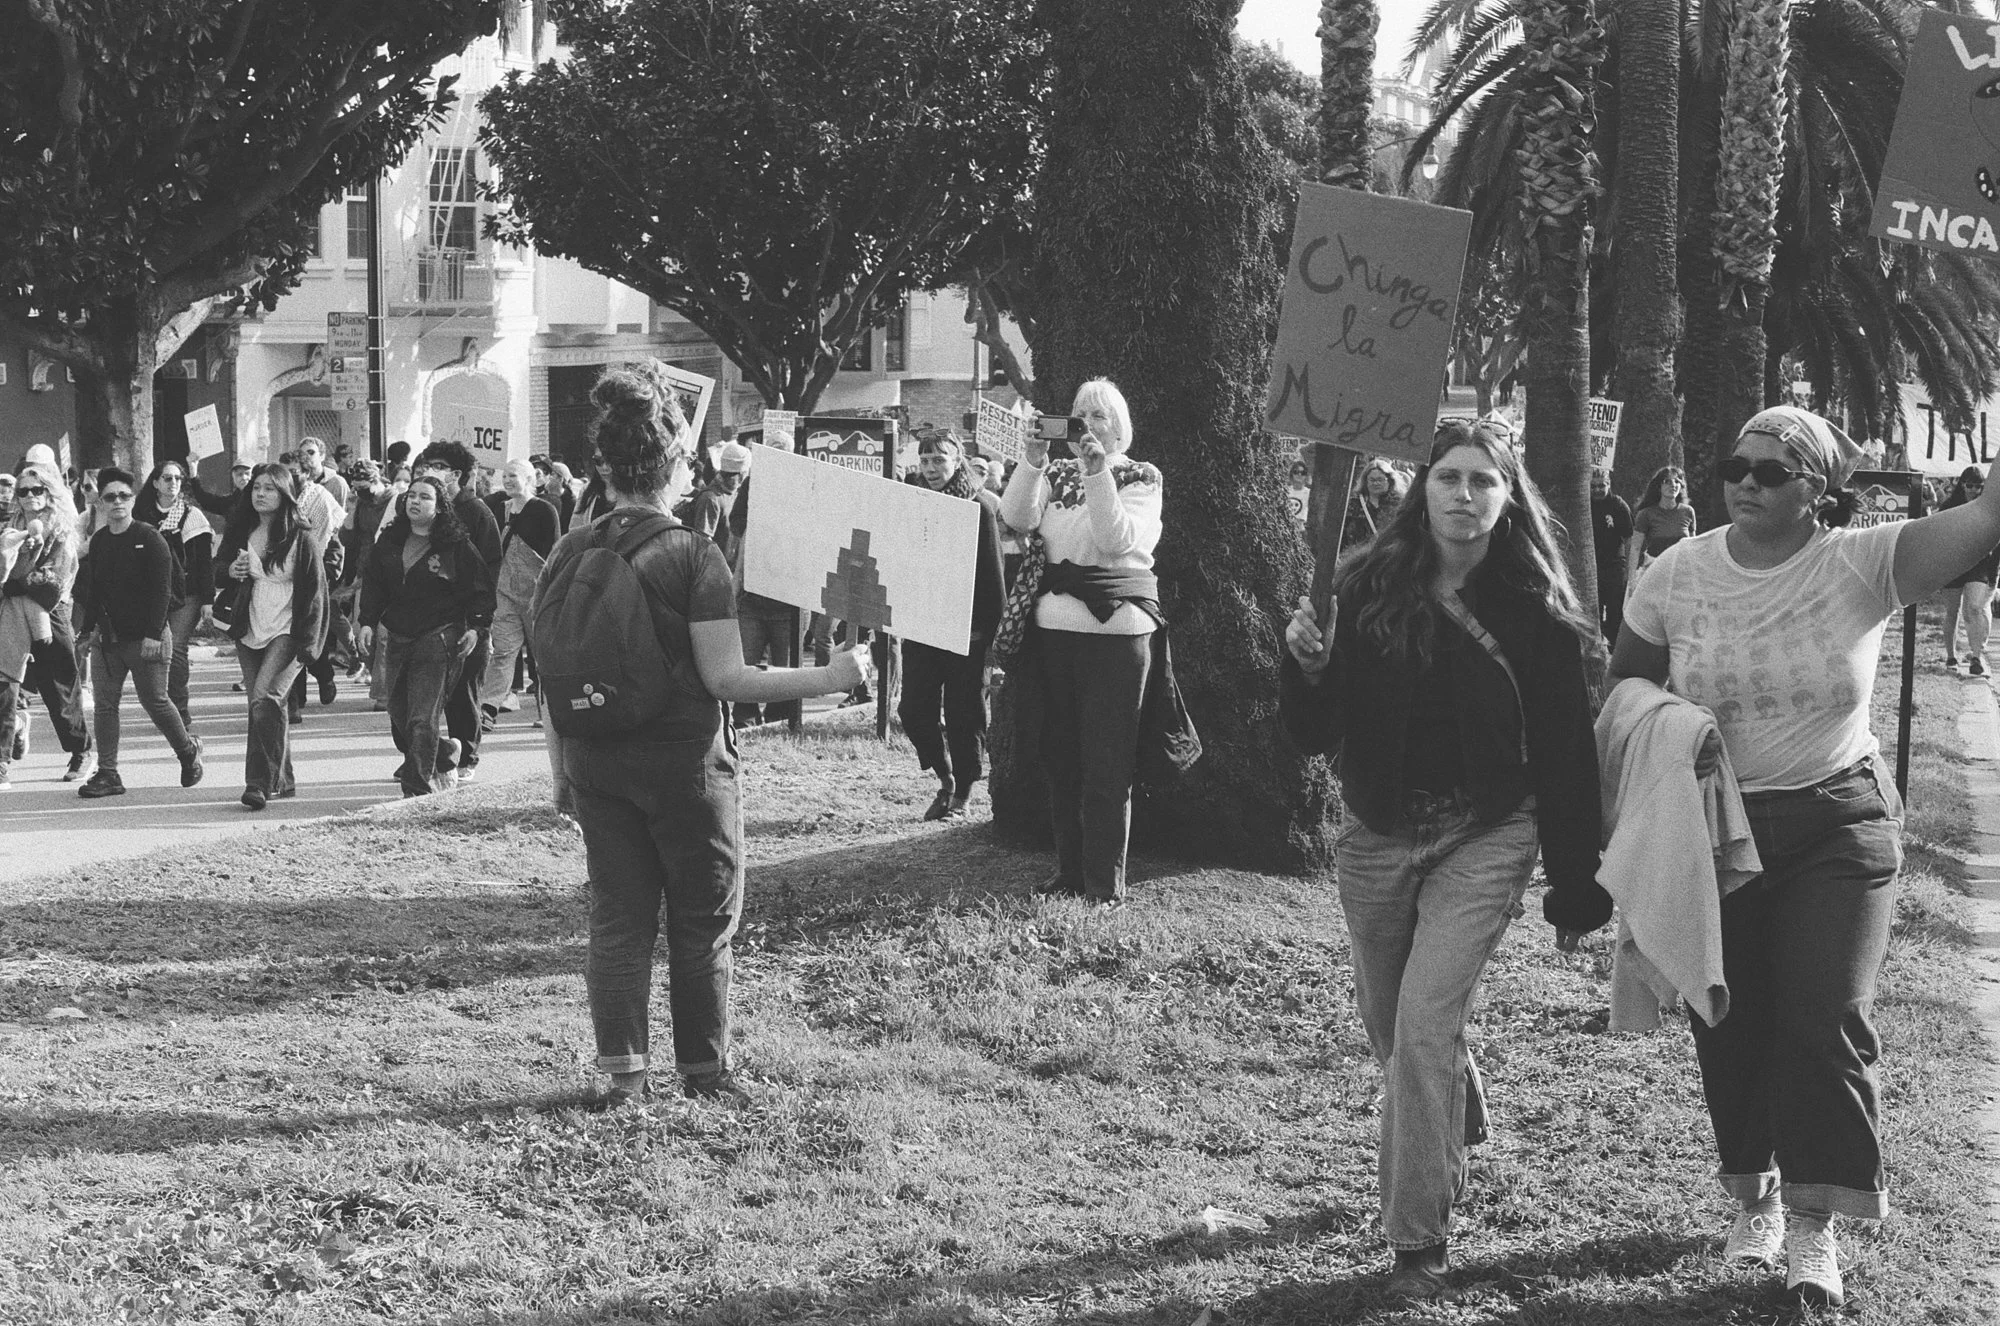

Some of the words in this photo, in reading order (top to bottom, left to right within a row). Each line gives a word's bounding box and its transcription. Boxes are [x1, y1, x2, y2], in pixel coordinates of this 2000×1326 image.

[1887, 201, 1999, 252] INCA
[1300, 234, 1448, 329] Chinga
[329, 314, 340, 325] NO
[1329, 304, 1376, 358] la
[333, 359, 341, 370] 2
[980, 401, 1020, 429] RESIST
[1268, 362, 1424, 446] Migra
[474, 427, 502, 451] ICE
[979, 413, 1019, 440] PREJUDICE
[832, 456, 882, 472] PARKING
[1851, 513, 1904, 528] ARKIN
